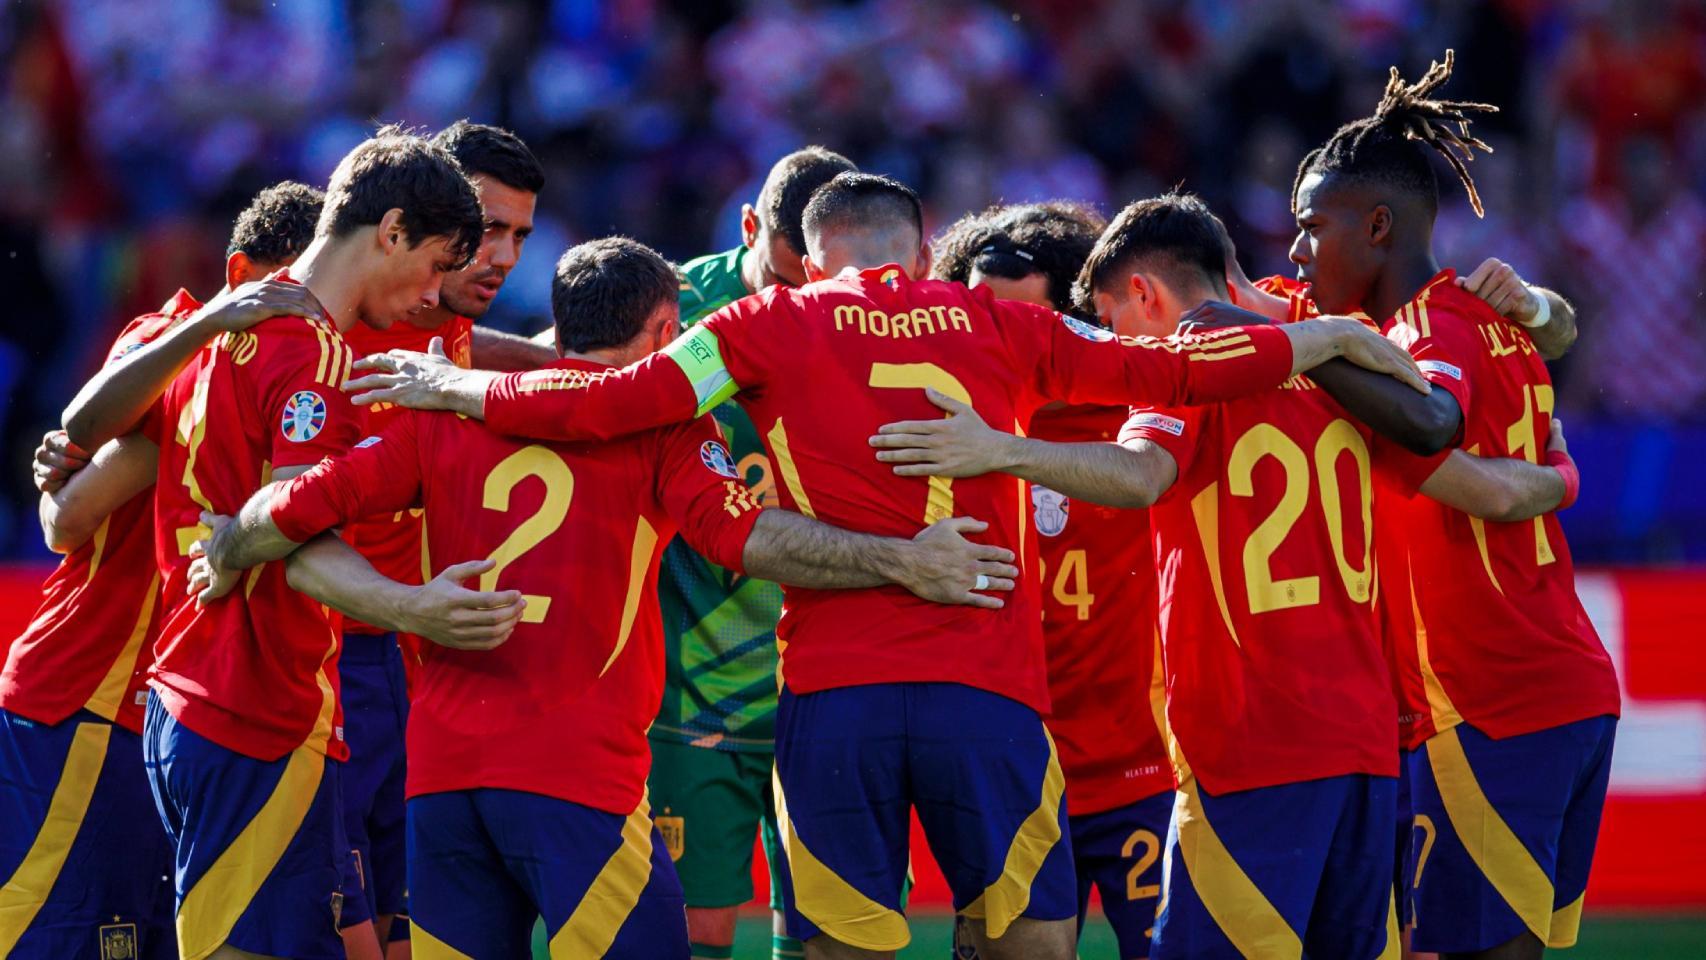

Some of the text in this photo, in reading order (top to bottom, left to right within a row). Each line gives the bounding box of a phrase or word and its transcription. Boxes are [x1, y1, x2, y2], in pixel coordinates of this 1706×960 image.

[687, 338, 711, 360] PECT
[834, 305, 972, 339] MORATA
[869, 362, 972, 526] 7
[480, 445, 574, 623] 2
[1228, 418, 1372, 615] 20
[1039, 550, 1095, 621] 4
[1121, 830, 1160, 901] 2
